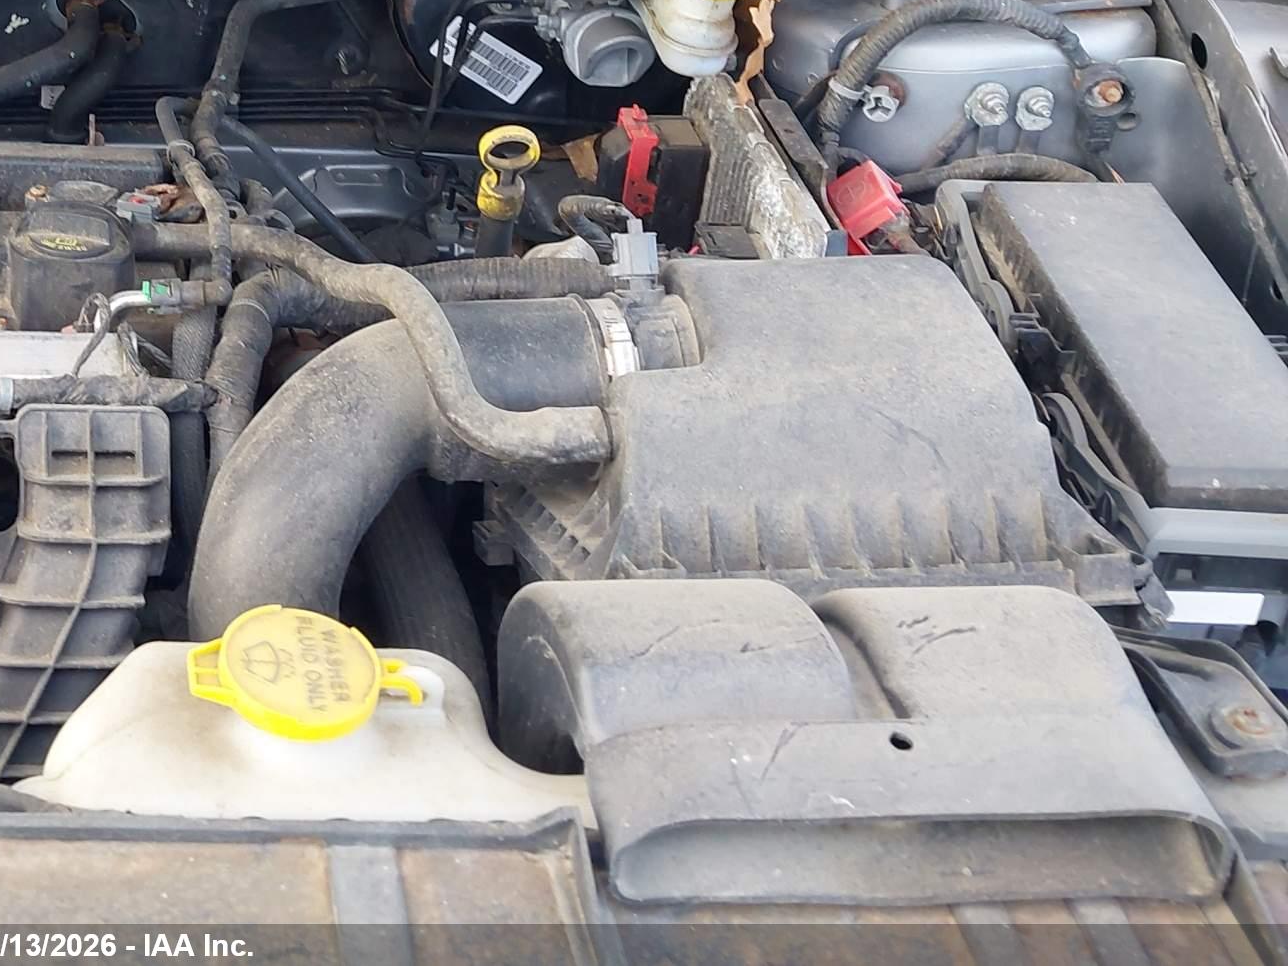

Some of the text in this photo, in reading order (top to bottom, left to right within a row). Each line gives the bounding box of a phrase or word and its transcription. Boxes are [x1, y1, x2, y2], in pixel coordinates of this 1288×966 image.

[295, 616, 328, 712] FLUID ONLY
[321, 628, 352, 702] WASHER
